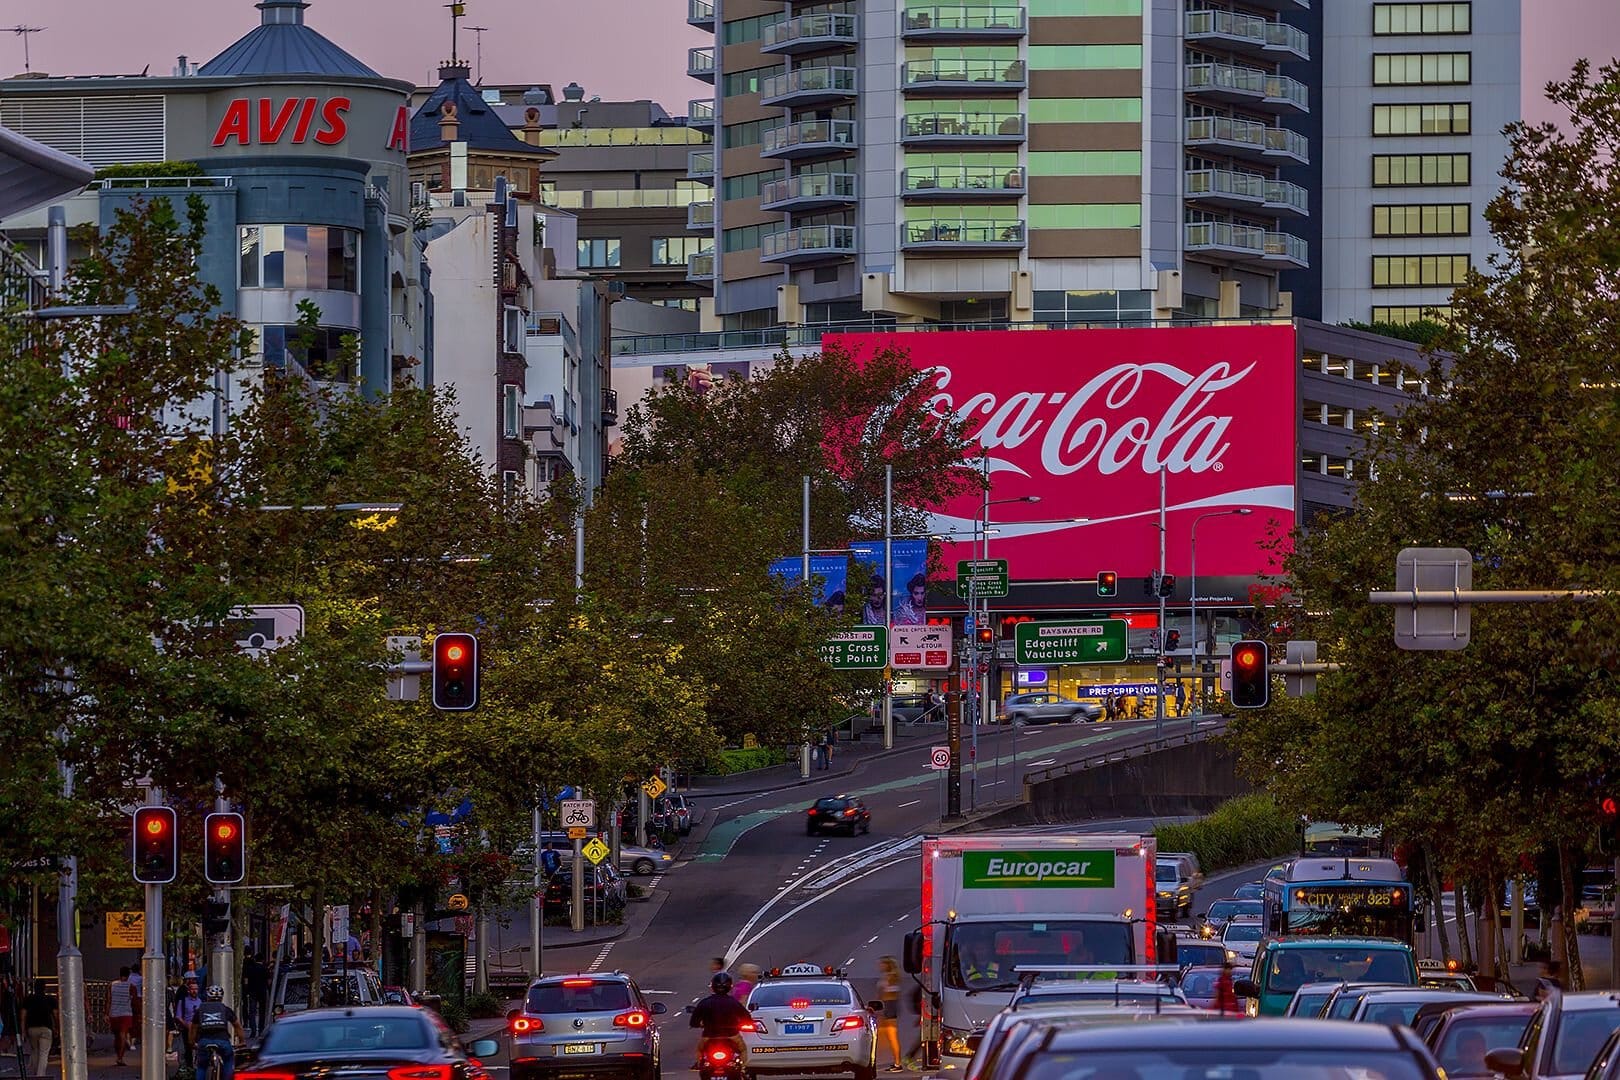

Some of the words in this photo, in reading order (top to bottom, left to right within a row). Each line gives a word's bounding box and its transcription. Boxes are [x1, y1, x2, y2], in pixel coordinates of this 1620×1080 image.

[211, 96, 351, 147] AVIS
[862, 361, 1257, 476] Coca-Cola
[1040, 627, 1088, 635] BAYSWATER
[848, 643, 880, 652] Cross
[1025, 638, 1079, 650] Edgecliff
[847, 654, 879, 663] Point
[1025, 650, 1078, 659] Vaucluse
[935, 754, 946, 762] 60
[987, 858, 1092, 881] Europcar
[1308, 893, 1334, 905] CITY
[1367, 893, 1390, 905] 325
[789, 966, 814, 974] TAXI
